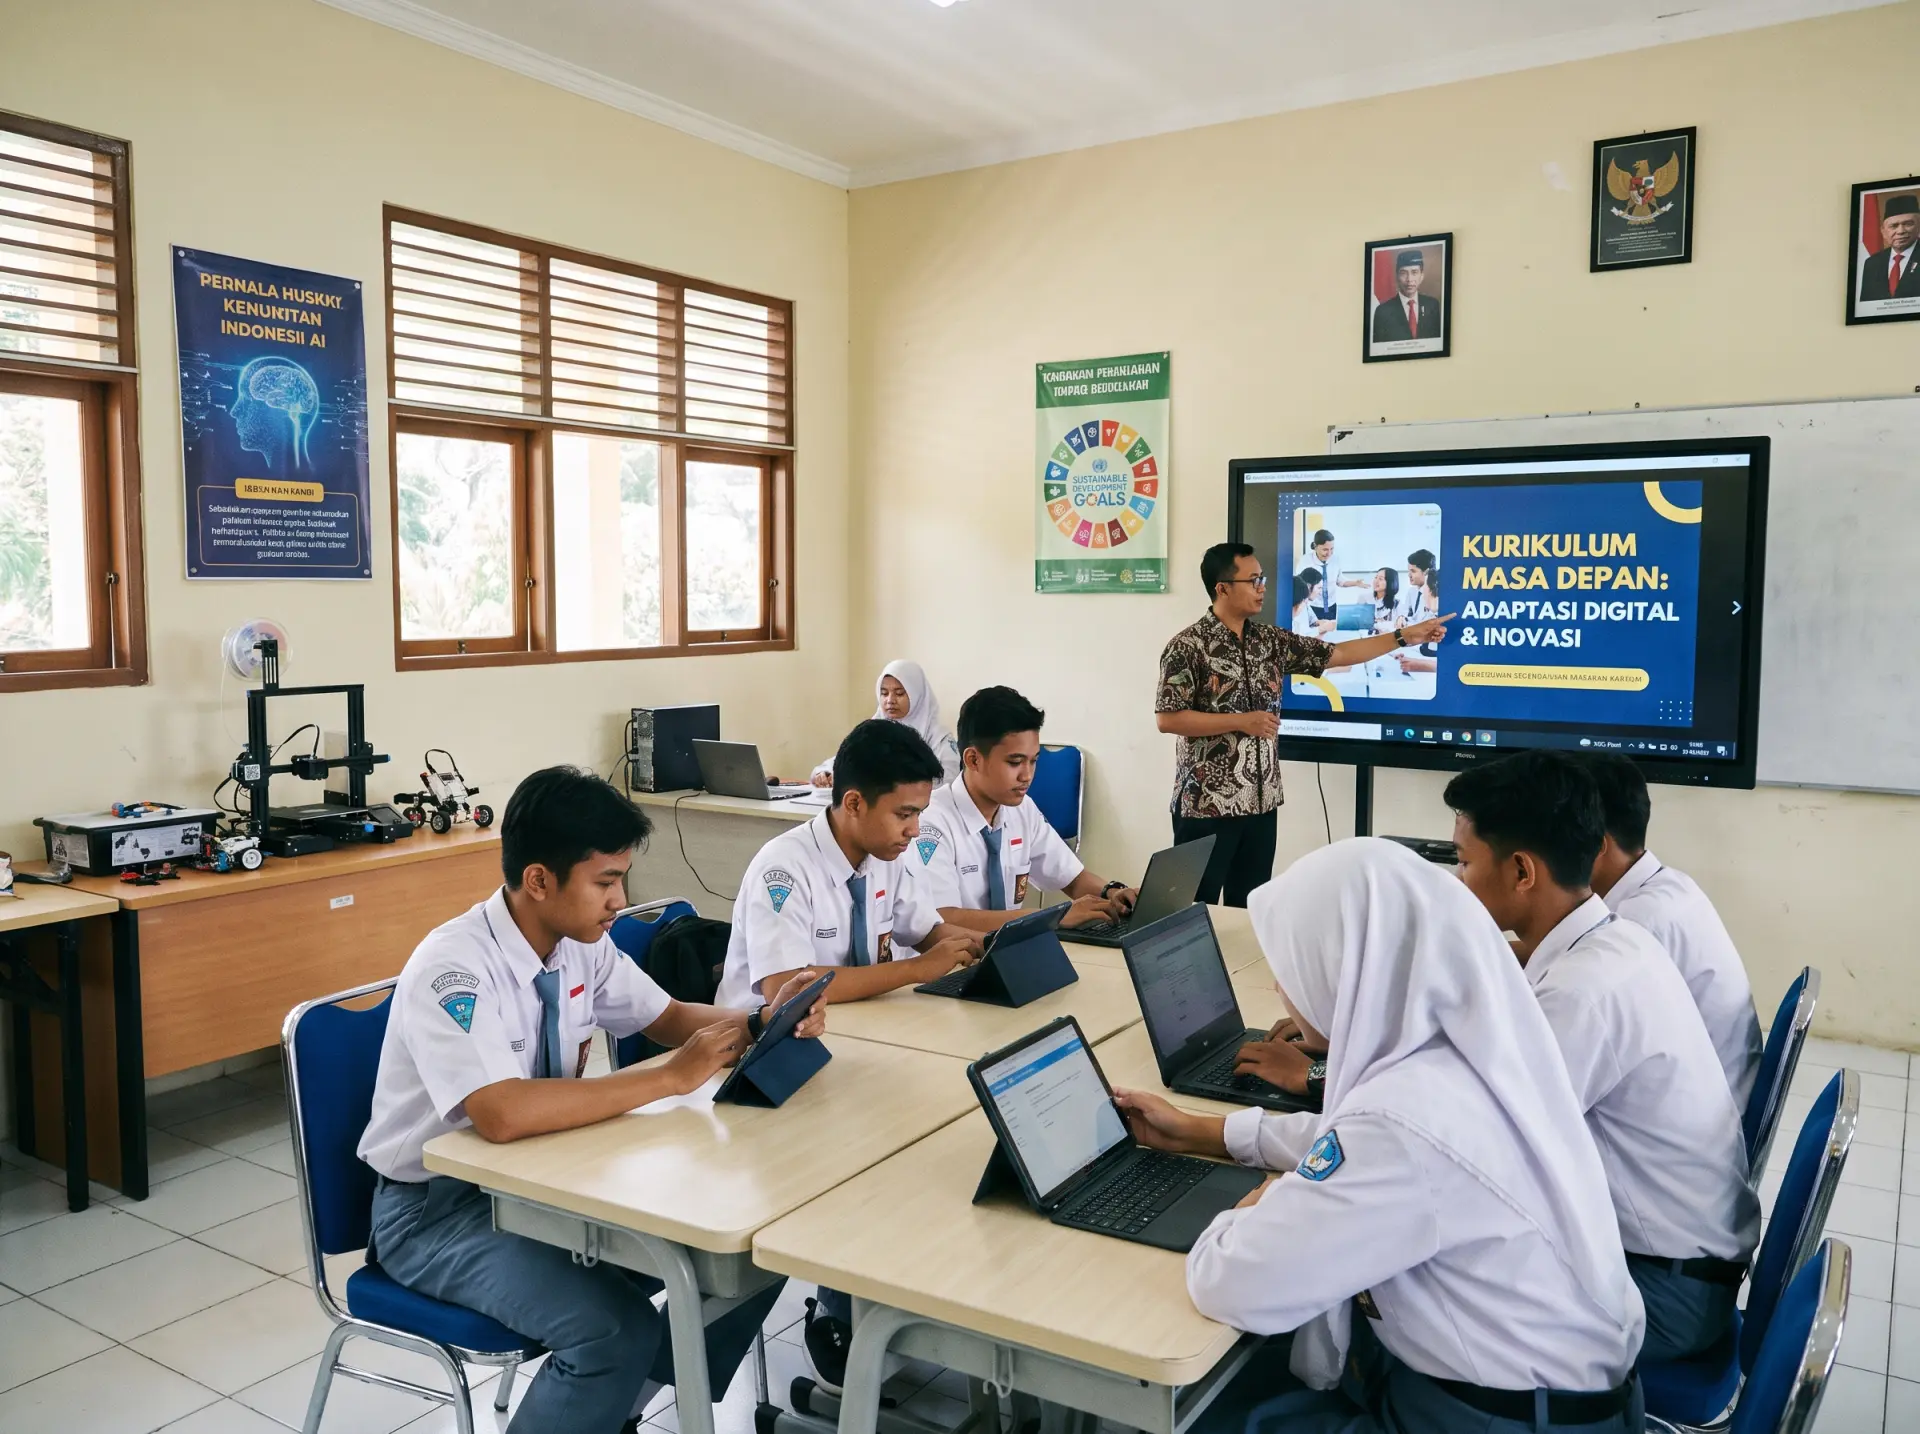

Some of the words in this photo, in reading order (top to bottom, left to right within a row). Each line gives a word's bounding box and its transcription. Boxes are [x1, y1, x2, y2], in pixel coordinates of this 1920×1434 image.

[200, 272, 279, 299] PERNALA
[309, 333, 326, 348] AI
[1072, 474, 1128, 484] SUSTAINABLE
[1072, 482, 1127, 493] DEVELOPMENT
[1074, 491, 1126, 507] GOALS
[1462, 533, 1637, 558] KURIKULUM
[1462, 566, 1550, 590] MASA
[1556, 566, 1669, 590] DEPAN:
[1461, 600, 1577, 620] ADAPTASI
[1584, 602, 1680, 622] DIGITAL
[1460, 627, 1479, 647] &
[1483, 627, 1581, 648] INOVASI
